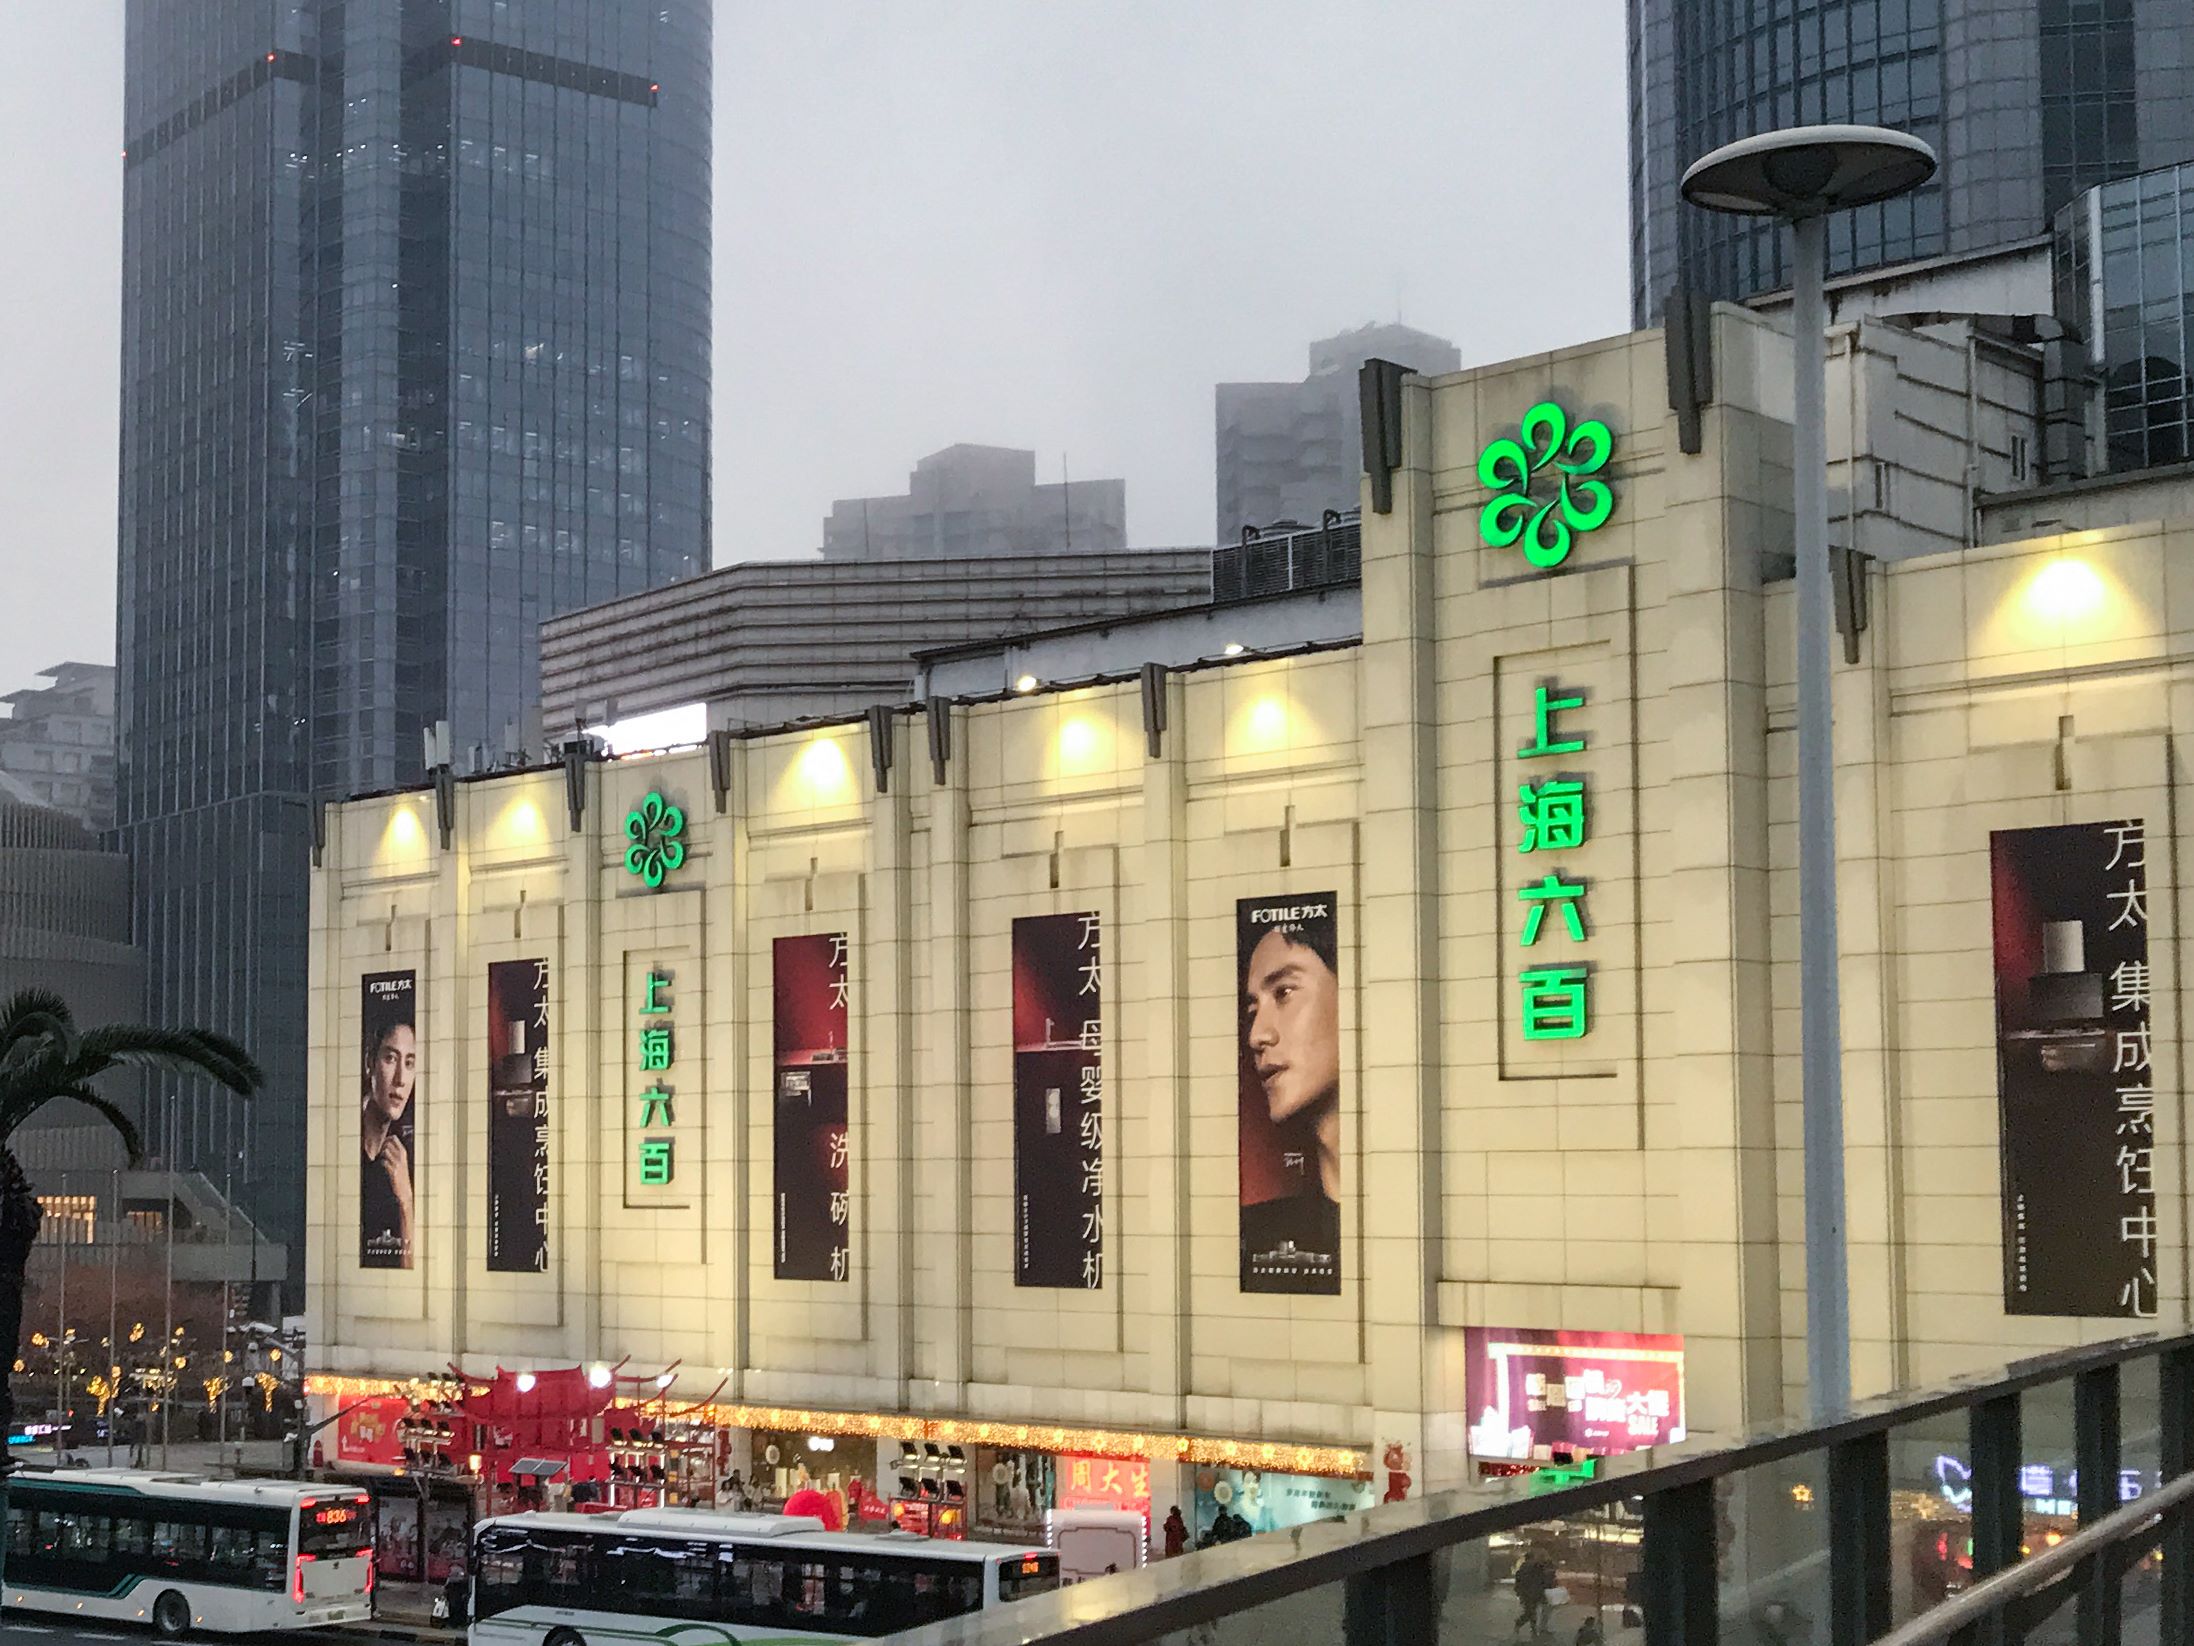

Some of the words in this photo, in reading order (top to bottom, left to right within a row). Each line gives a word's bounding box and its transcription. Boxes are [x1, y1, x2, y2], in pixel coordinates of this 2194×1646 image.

[1517, 686, 1589, 1041] 上海六百
[2103, 818, 2149, 933] 方太
[1077, 911, 1101, 997] 方太
[1251, 907, 1300, 924] FOTILE
[1301, 904, 1328, 919] 方太
[828, 932, 848, 1011] 方太
[639, 971, 671, 1186] 上海六百
[1071, 1460, 1150, 1497] 周大生
